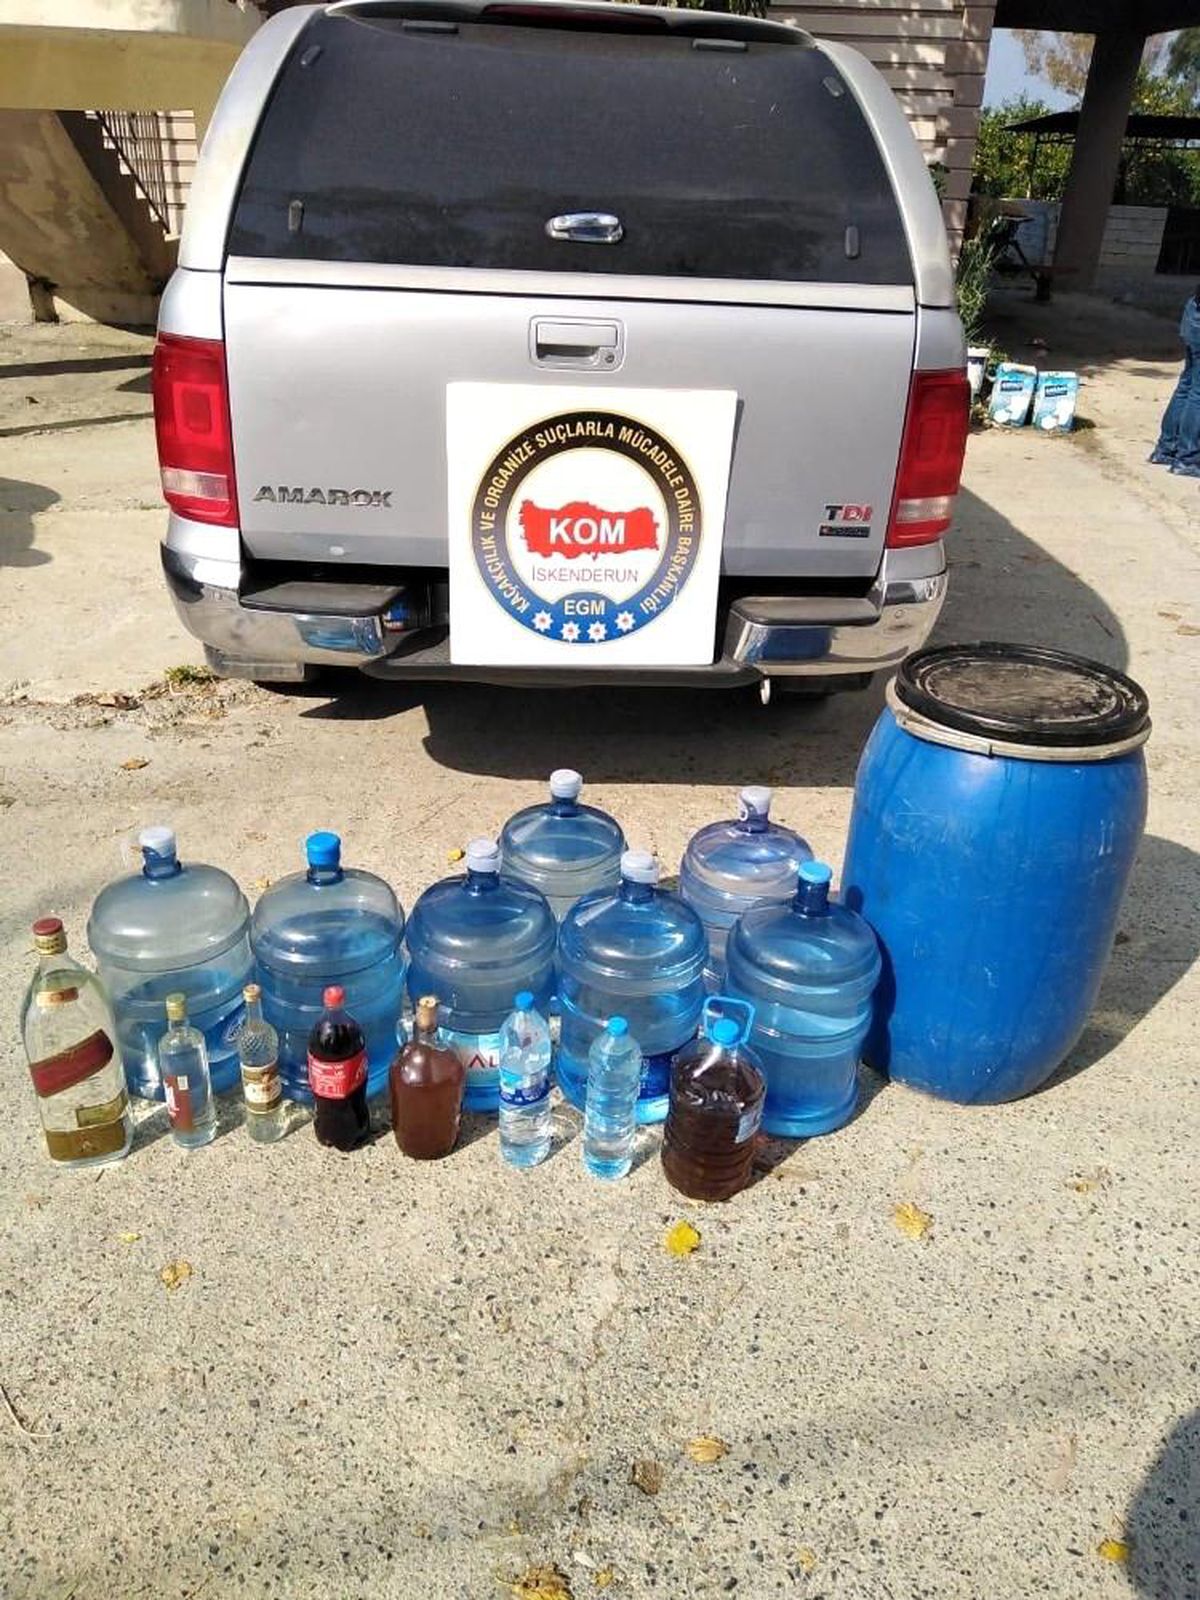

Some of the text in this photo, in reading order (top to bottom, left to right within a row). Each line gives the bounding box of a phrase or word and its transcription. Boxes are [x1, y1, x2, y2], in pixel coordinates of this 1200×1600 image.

[252, 486, 393, 507] AMAROK
[480, 421, 695, 614] KAÇAKÇILIK VE ORGANİZE SUÇLARLA MÜCADELE DAİRE BAŞKANLIĞI
[825, 504, 873, 521] TDI
[549, 517, 626, 545] KOM
[532, 565, 639, 583] İSKENDERUN
[564, 599, 606, 616] EGM
